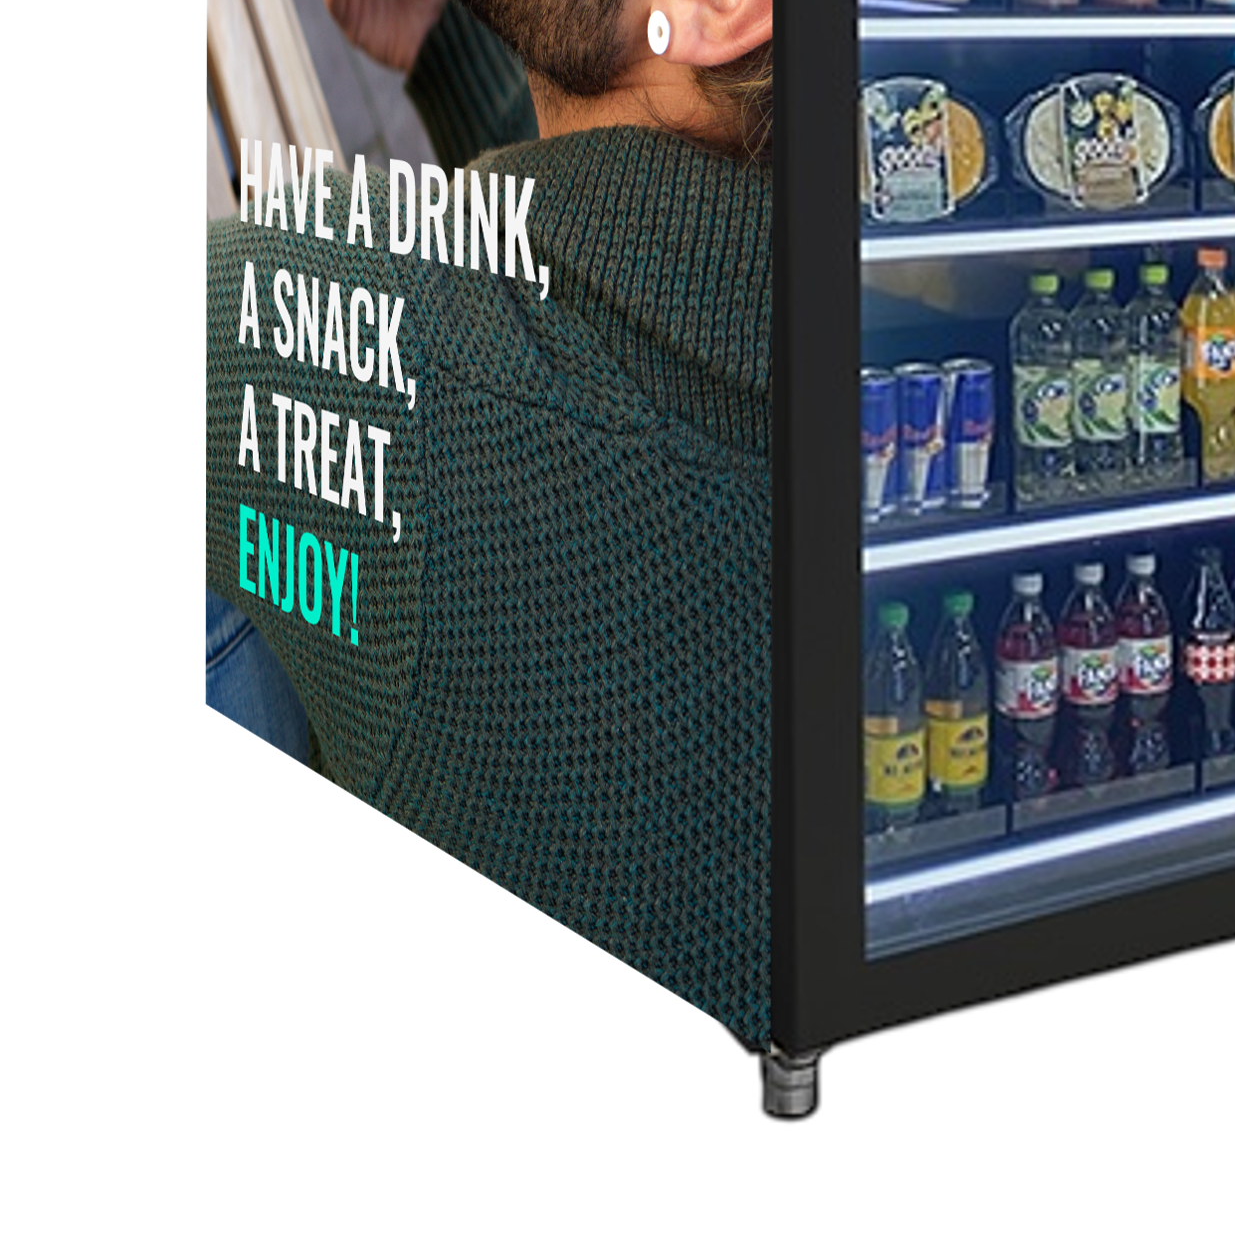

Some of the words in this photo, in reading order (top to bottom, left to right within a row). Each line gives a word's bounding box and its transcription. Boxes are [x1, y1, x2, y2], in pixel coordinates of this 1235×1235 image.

[240, 138, 334, 240] HAVE
[347, 154, 372, 248] A
[389, 158, 549, 300] DRINK,
[238, 261, 261, 348] A
[274, 269, 416, 410] SNACK,
[238, 384, 260, 473] A
[272, 393, 401, 543] TREAT,
[239, 504, 359, 646] ENJOY!
